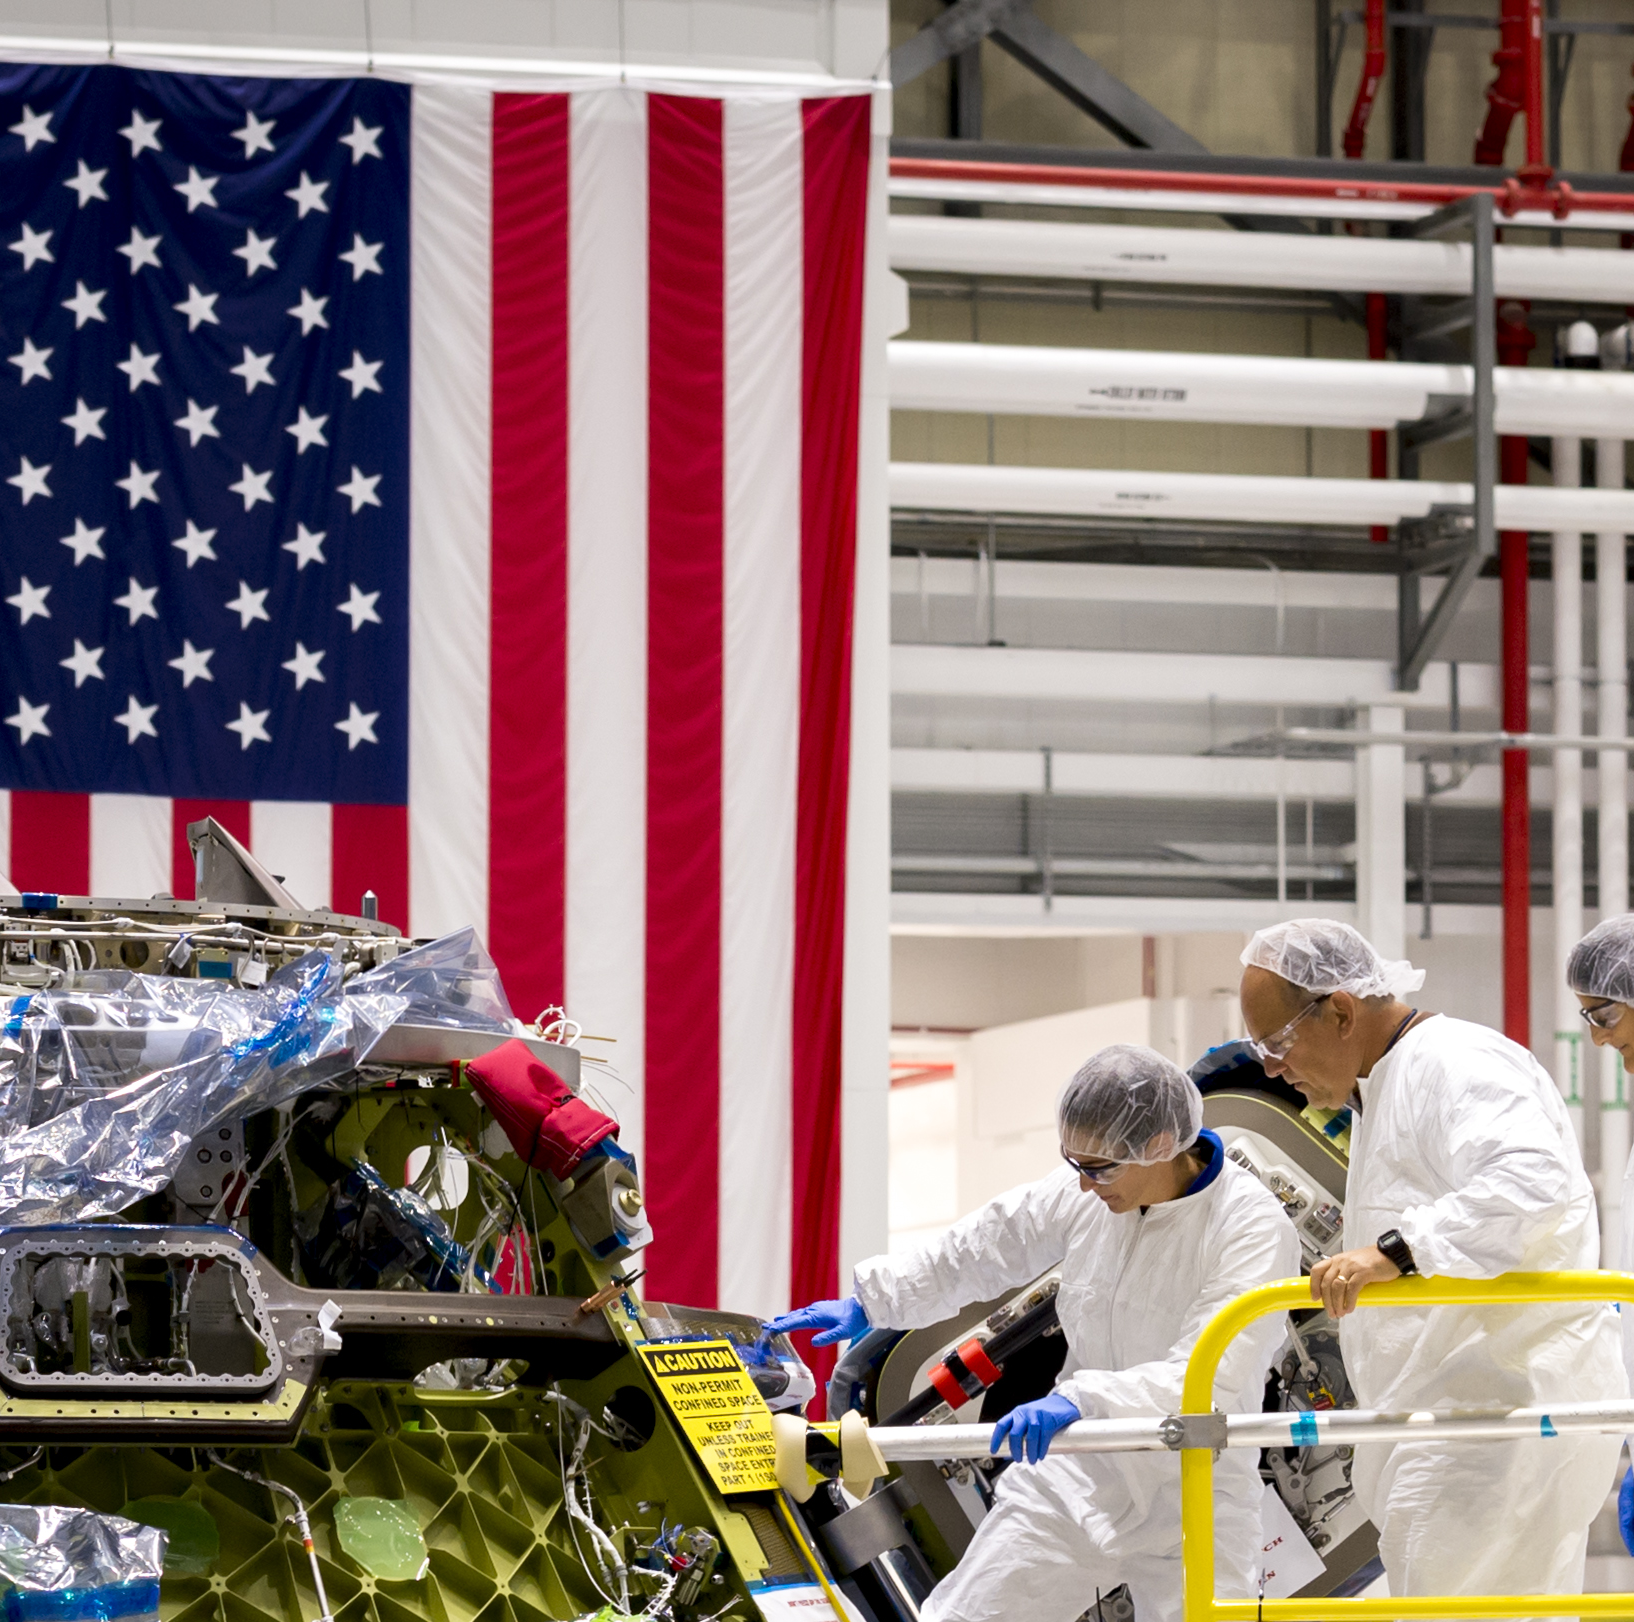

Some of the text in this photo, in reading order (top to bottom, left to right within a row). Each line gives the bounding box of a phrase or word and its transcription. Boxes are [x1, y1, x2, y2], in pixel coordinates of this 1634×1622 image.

[664, 1350, 736, 1371] CAUTION
[671, 1379, 743, 1395] NON-PERMIT
[673, 1394, 763, 1411] CONFINED SPACE
[706, 1419, 755, 1432] KEEP OUT
[697, 1431, 774, 1447] UNLESS TRAINE
[715, 1445, 776, 1459] IN CONFINED
[718, 1458, 775, 1472] SPACE ENTR
[721, 1473, 746, 1487] PART
